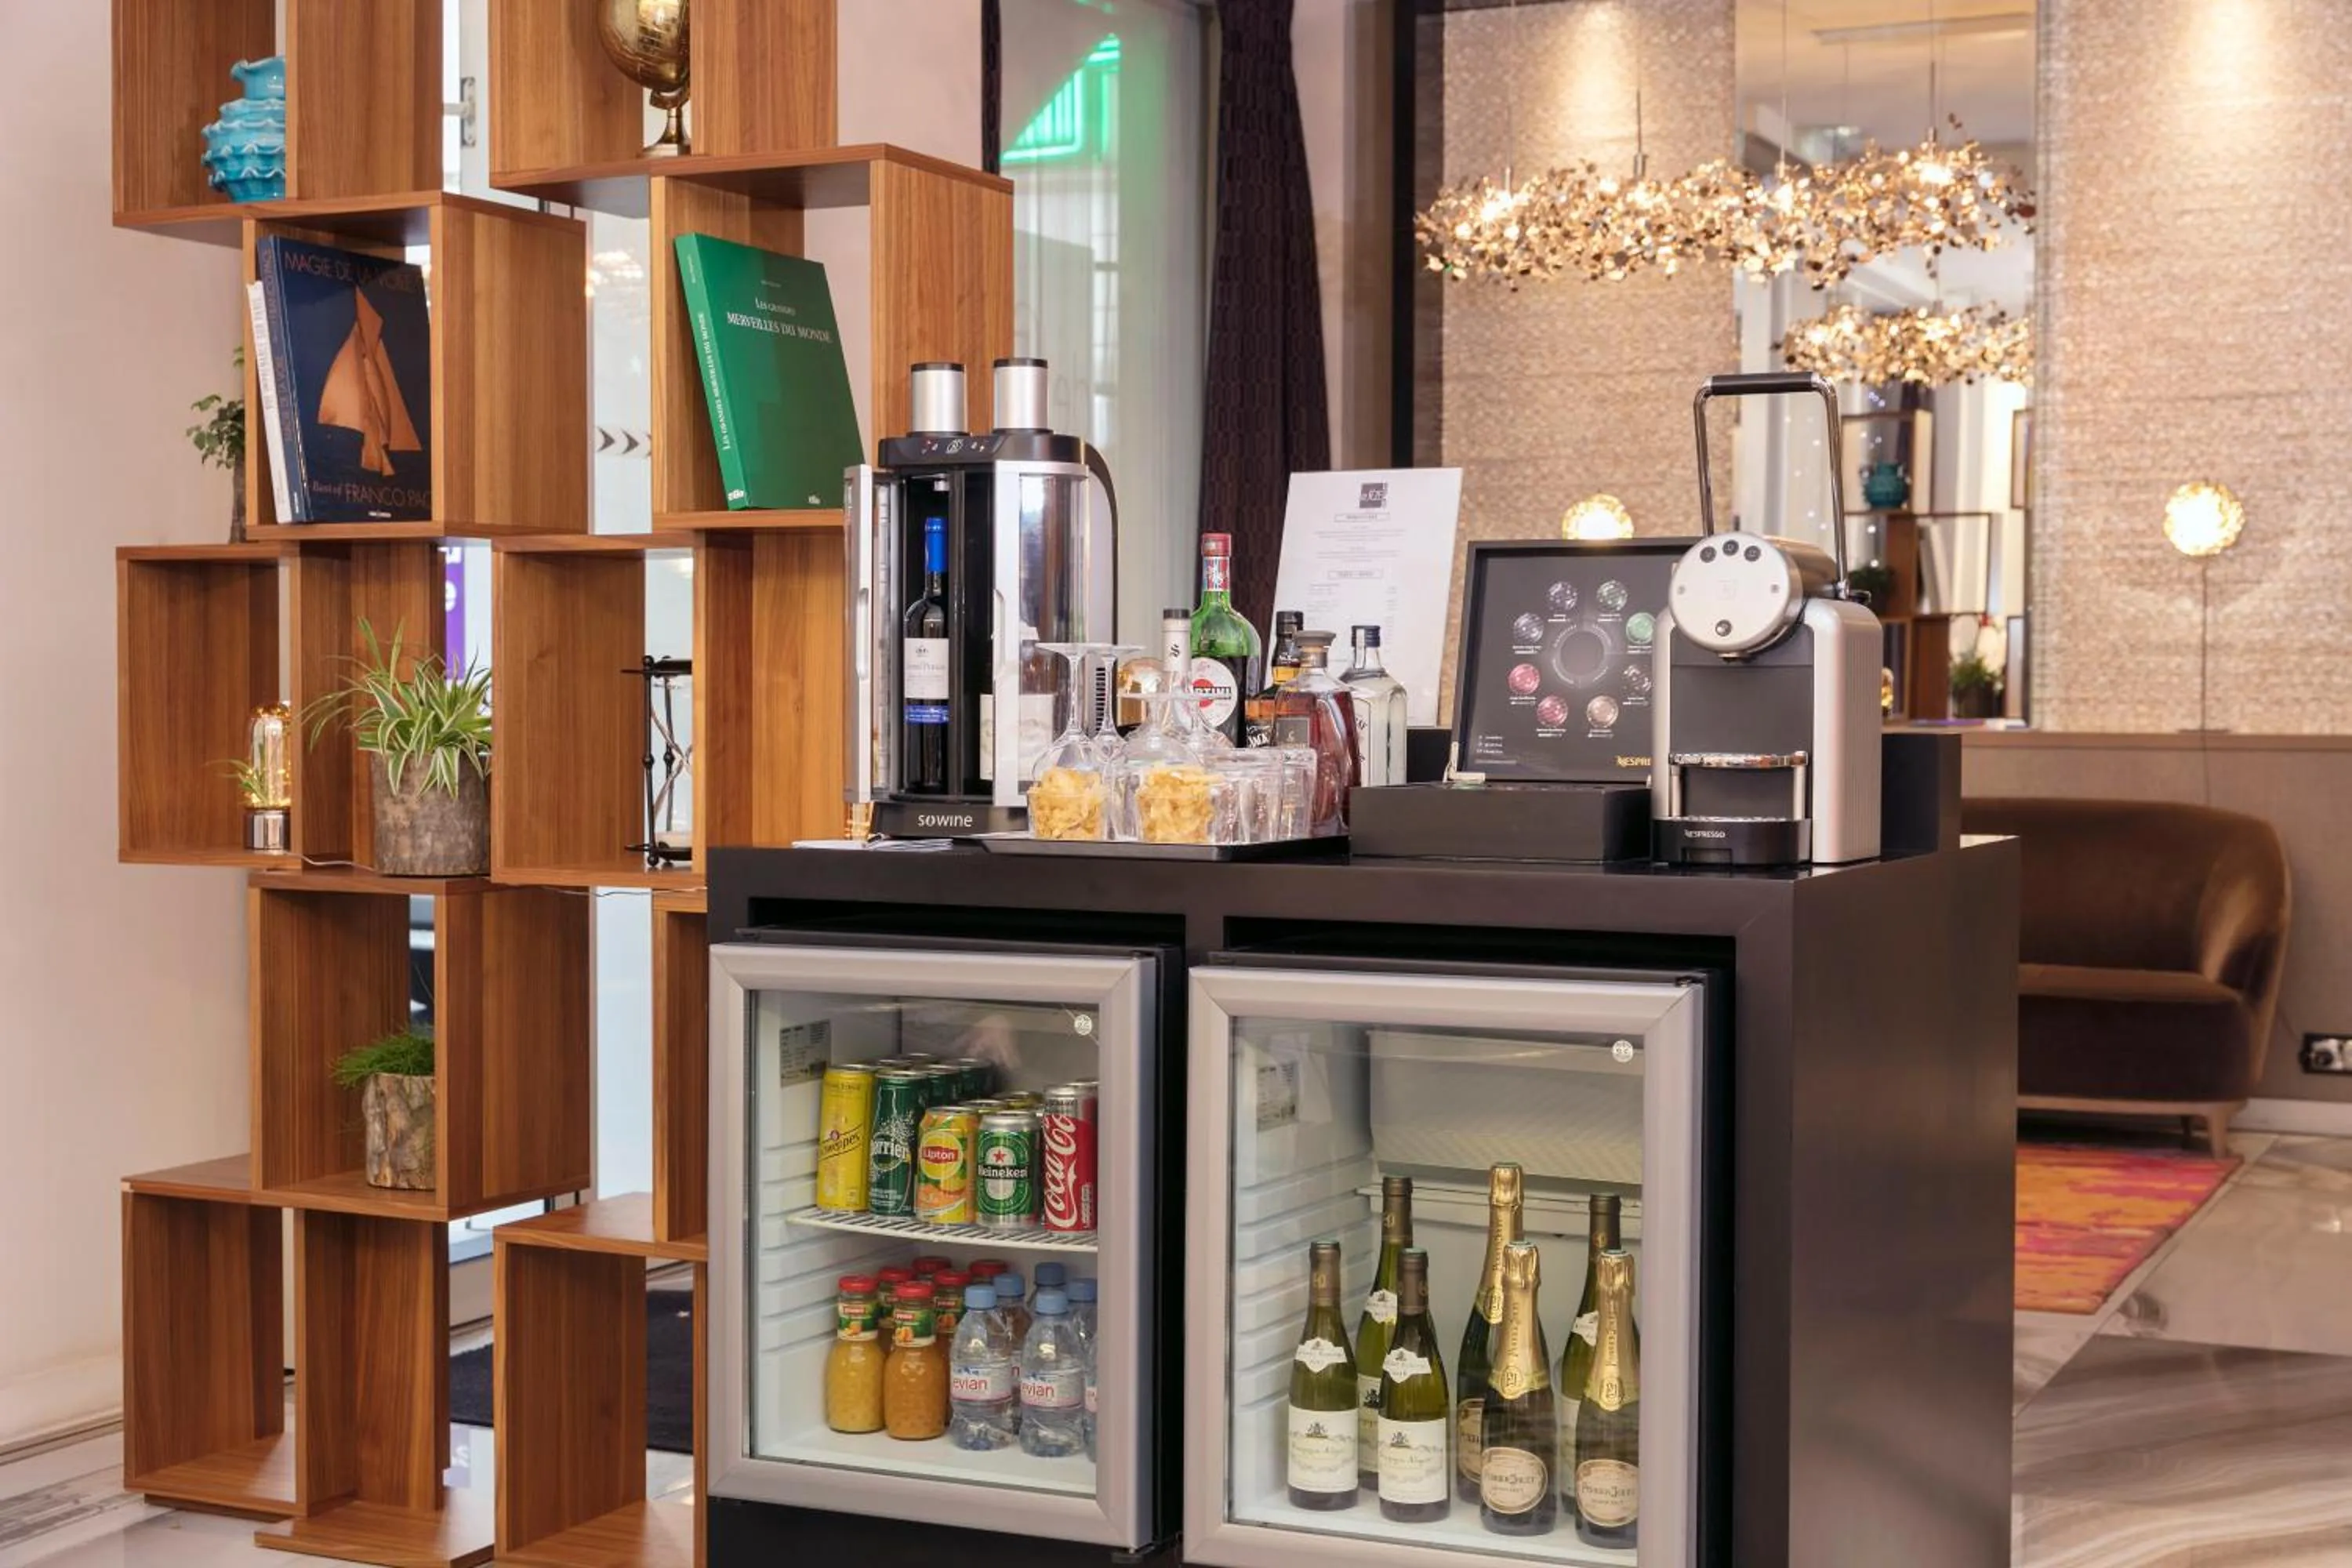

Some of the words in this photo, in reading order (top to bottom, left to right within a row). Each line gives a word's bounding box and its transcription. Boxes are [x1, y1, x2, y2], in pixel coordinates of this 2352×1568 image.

[917, 815, 973, 828] sowine
[1684, 829, 1726, 838] NESPRESSO
[953, 1377, 988, 1391] evian
[1022, 1382, 1054, 1398] evian
